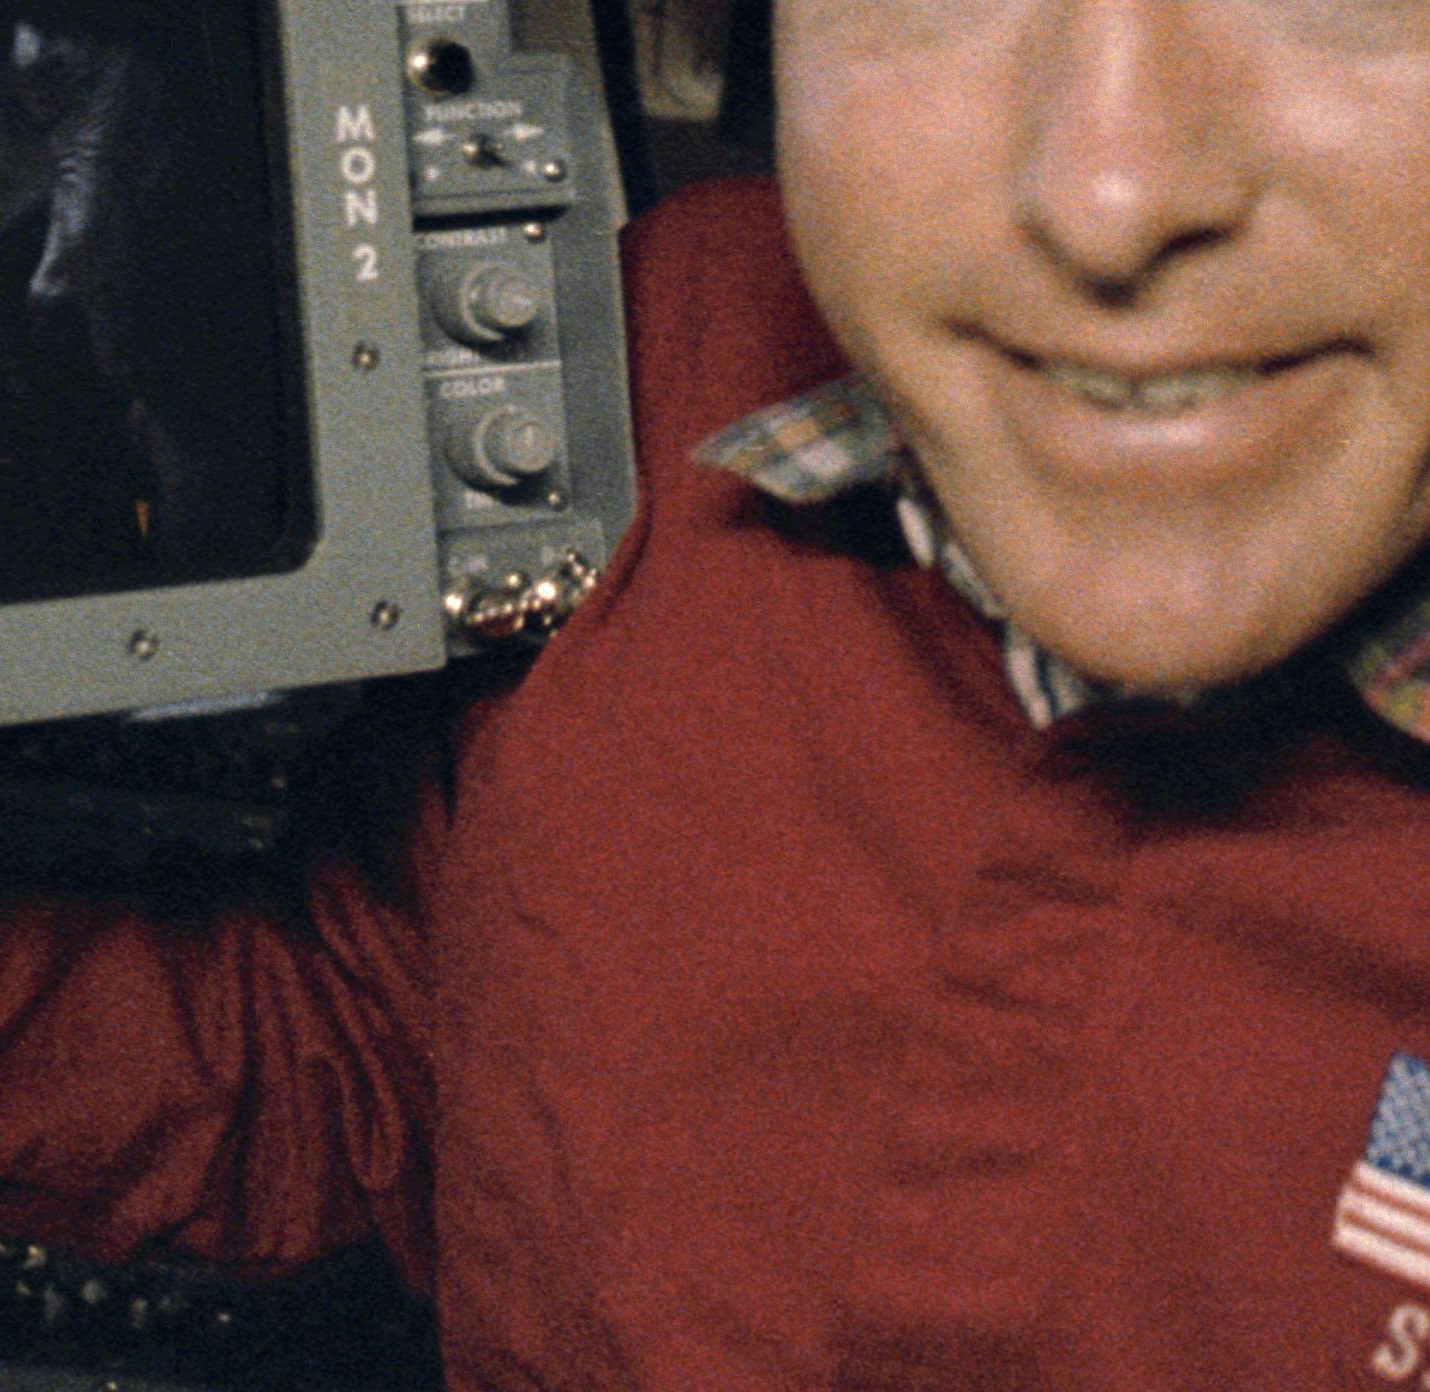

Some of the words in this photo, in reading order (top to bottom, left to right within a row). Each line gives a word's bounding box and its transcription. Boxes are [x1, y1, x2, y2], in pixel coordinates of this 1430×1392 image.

[423, 101, 523, 122] FUNCTION
[335, 104, 378, 229] MON
[352, 244, 379, 281] 2
